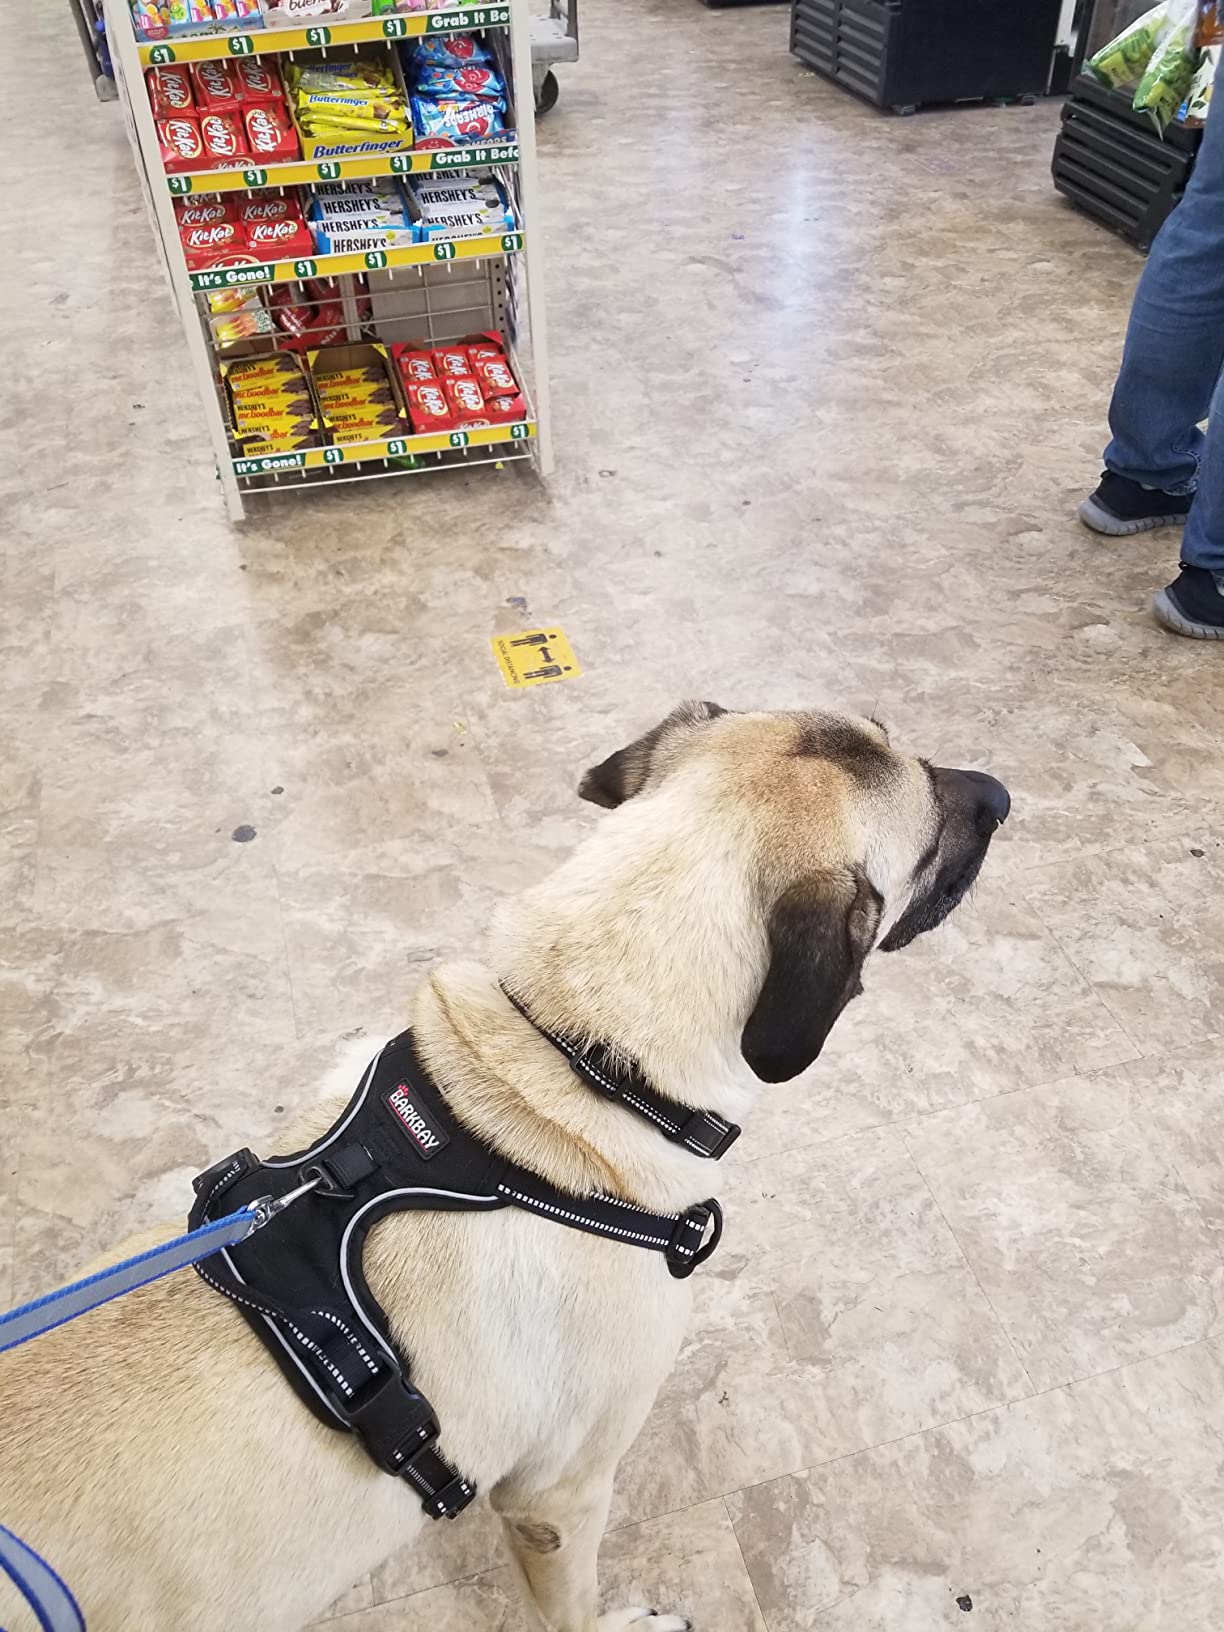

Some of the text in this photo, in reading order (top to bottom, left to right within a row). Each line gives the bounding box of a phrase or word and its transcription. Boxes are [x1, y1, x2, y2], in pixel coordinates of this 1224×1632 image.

[289, 0, 326, 11] buen
[386, 19, 402, 35] $1
[431, 13, 469, 28] Grab
[474, 12, 486, 24] It
[310, 28, 326, 45] $1
[232, 38, 248, 54] $1
[153, 49, 170, 64] $1
[313, 139, 404, 159] Butterfinger
[435, 148, 471, 164] Grab
[476, 149, 487, 160] It
[321, 162, 336, 177] $1
[393, 156, 407, 170] $1
[172, 176, 187, 192] $1
[247, 169, 262, 184] $1
[421, 188, 477, 204] HERSHEY'S
[324, 198, 381, 214] HERSHEY'S
[504, 235, 517, 250] $1
[437, 244, 451, 259] $1
[368, 252, 383, 268] $1
[198, 273, 221, 287] It's
[226, 266, 270, 283] Gone!
[297, 261, 313, 276] $1
[453, 433, 465, 446] $1
[513, 425, 525, 438] $1
[390, 441, 404, 454] $1
[236, 454, 302, 474] It's Gone!
[326, 450, 340, 463] $1
[389, 1089, 440, 1149] BARKBAY
